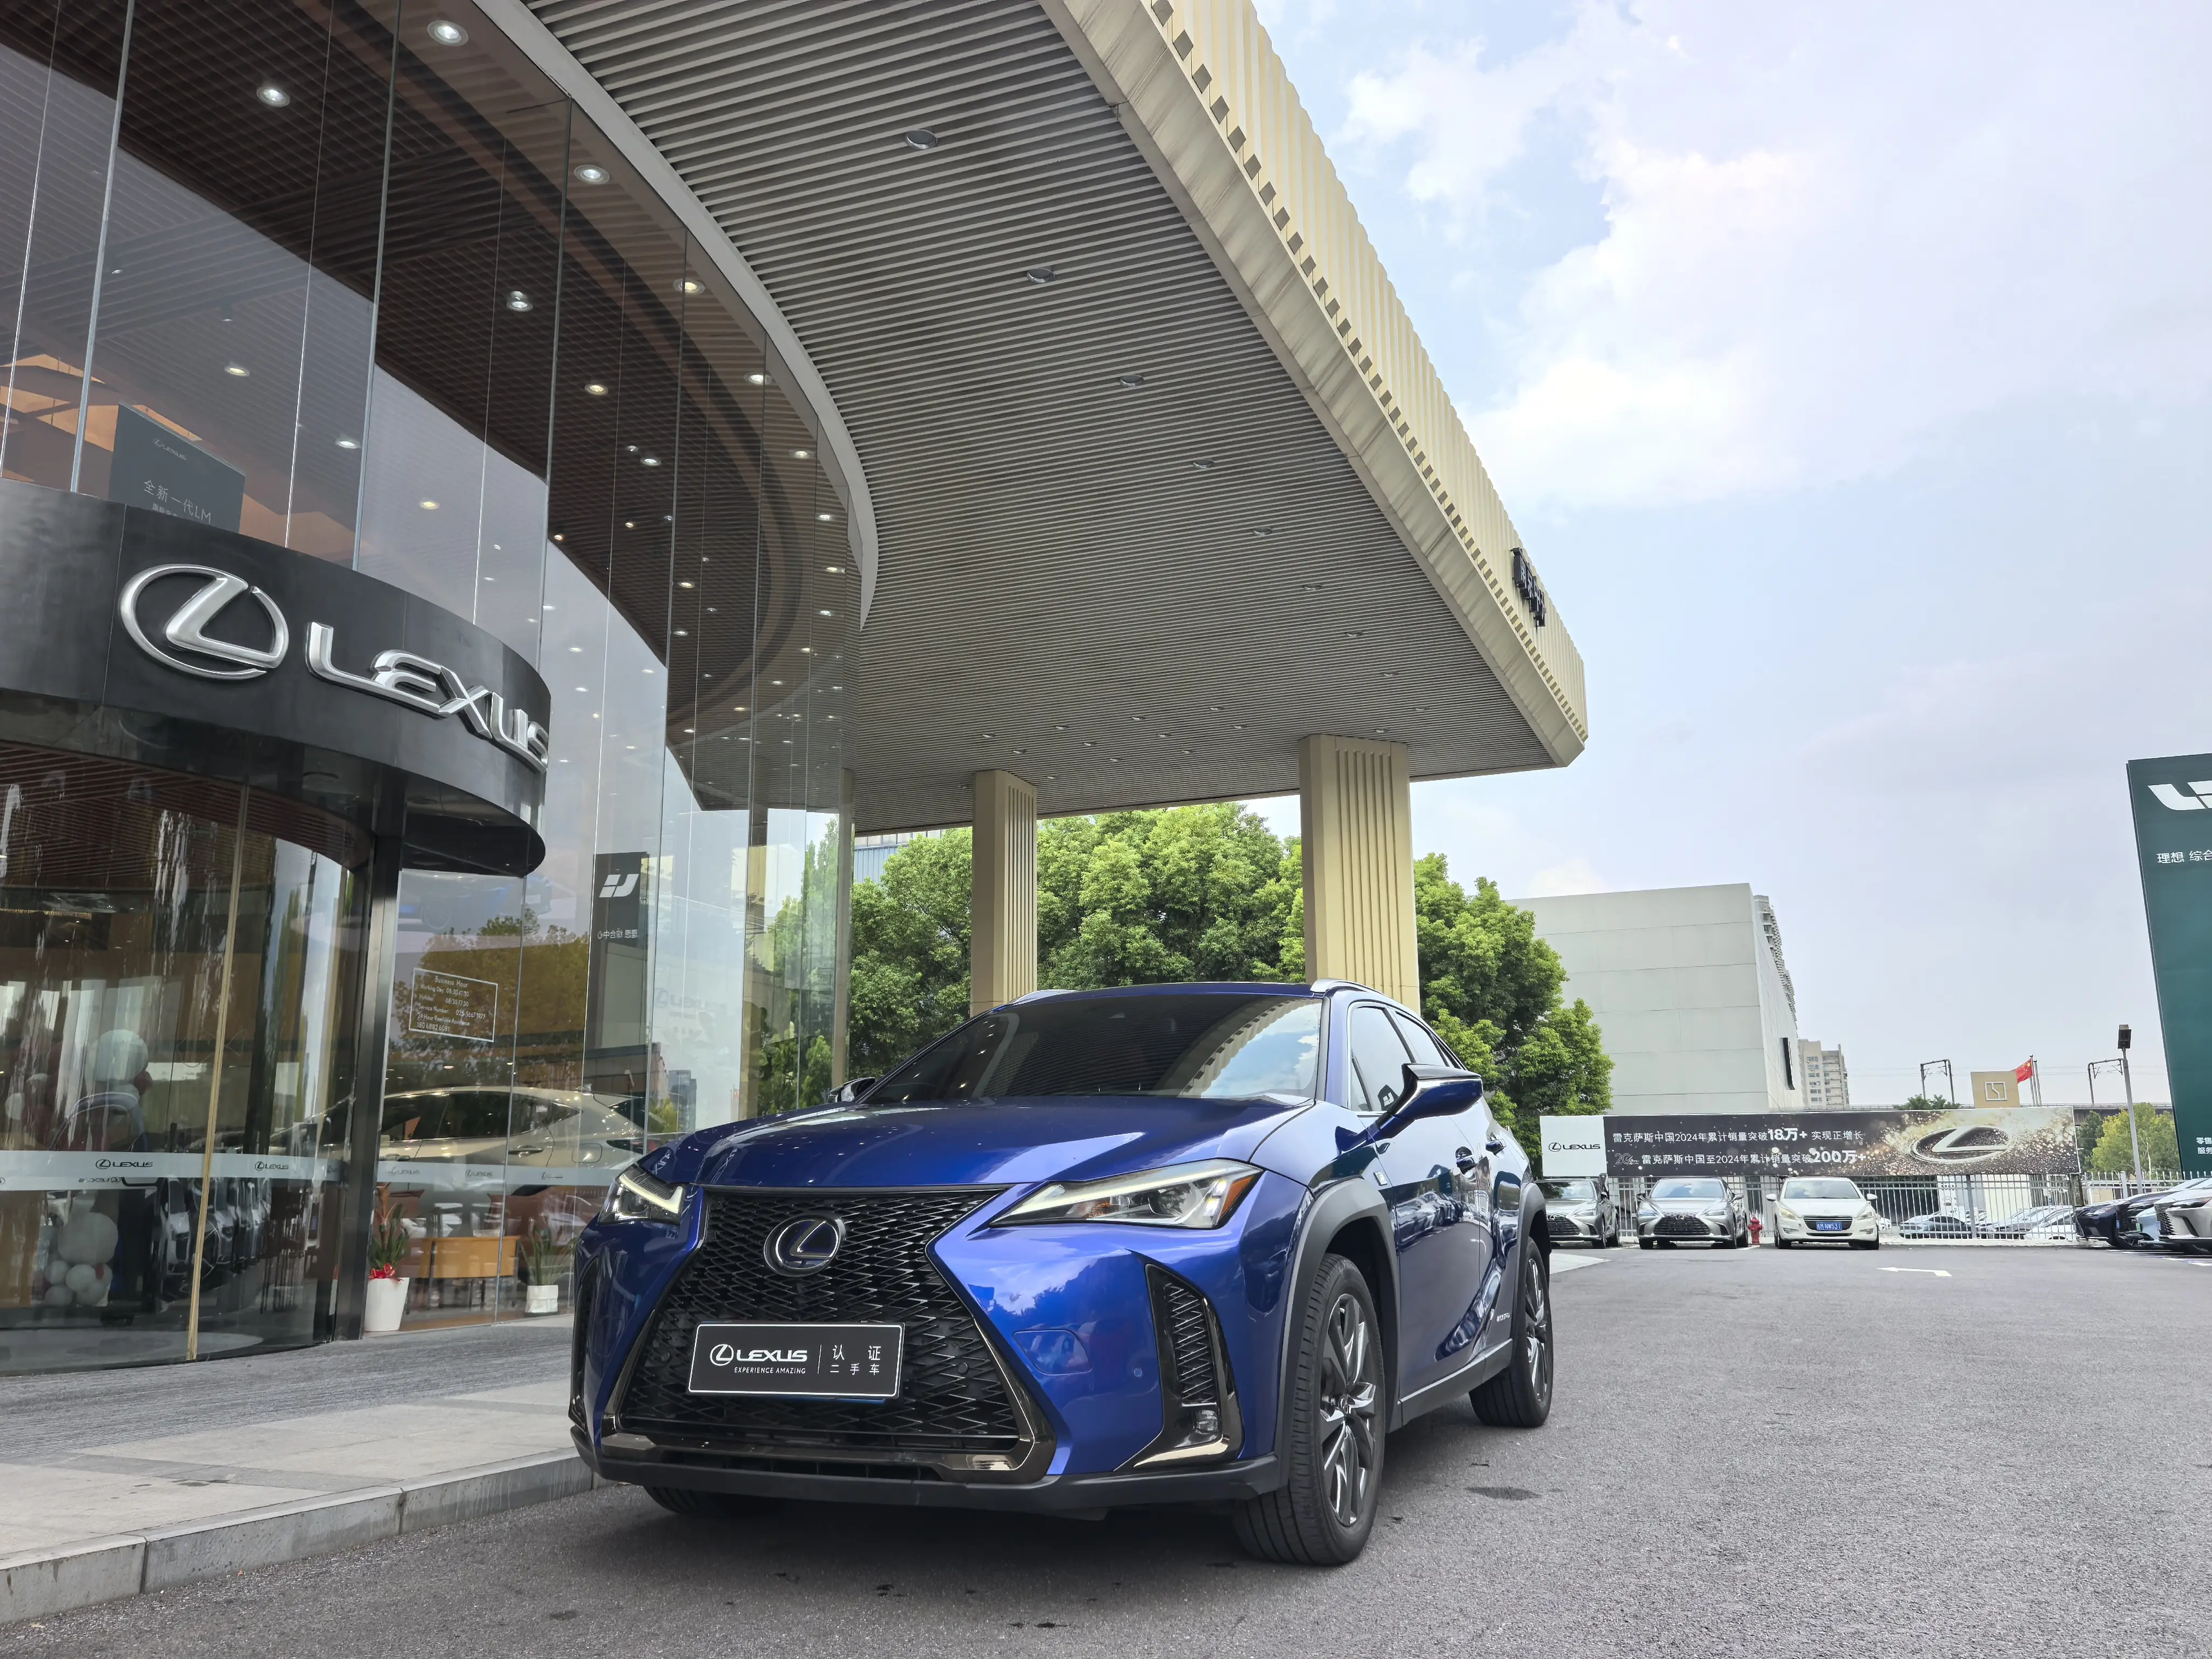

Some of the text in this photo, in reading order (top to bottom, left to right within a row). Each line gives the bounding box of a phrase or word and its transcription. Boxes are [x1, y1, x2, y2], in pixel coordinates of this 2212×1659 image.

[144, 480, 212, 524] 全新一代LM
[306, 621, 549, 774] LEXUS
[2156, 849, 2212, 864] 理想 综合
[435, 975, 468, 987] Business Hour
[1811, 1130, 1864, 1141] 实现正增长
[736, 1349, 808, 1362] LEXUS
